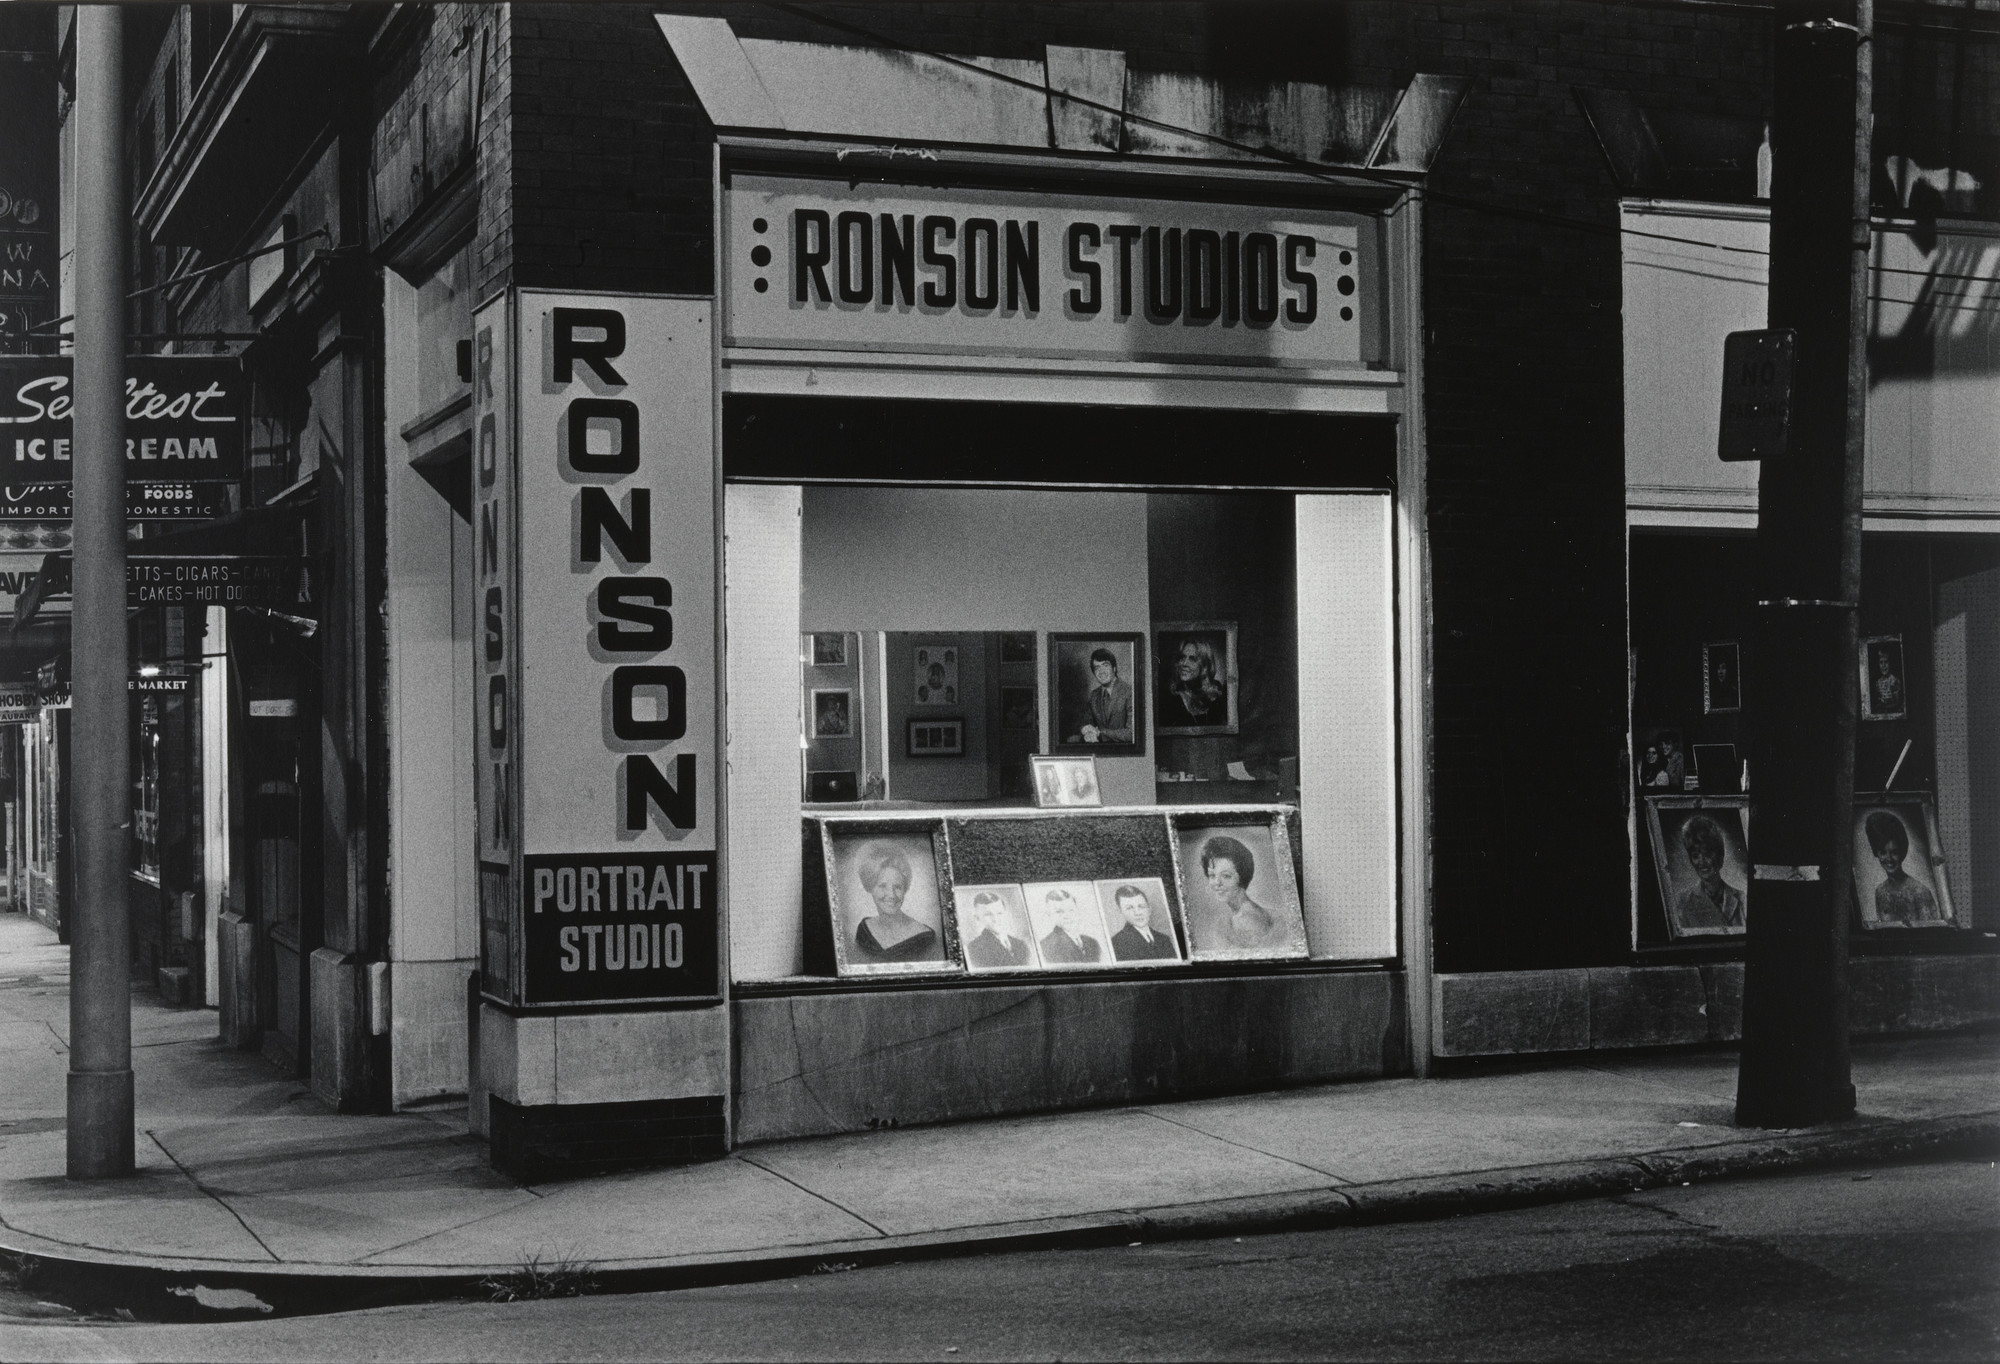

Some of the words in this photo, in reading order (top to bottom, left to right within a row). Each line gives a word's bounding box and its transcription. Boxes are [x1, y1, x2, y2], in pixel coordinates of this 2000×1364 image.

[789, 208, 1041, 319] RONSON
[1063, 222, 1318, 329] STUDIOS
[1740, 361, 1776, 386] NO
[0, 375, 237, 424] Setest
[15, 438, 71, 461] ICE
[126, 437, 219, 460] REAM
[126, 506, 212, 515] OMESTIC
[144, 489, 194, 500] FOODS
[477, 325, 510, 848] RONSON
[542, 306, 697, 842] RONSON
[138, 680, 188, 690] MARKET
[534, 864, 708, 914] PORTRAIT
[559, 922, 684, 973] STUDIO
